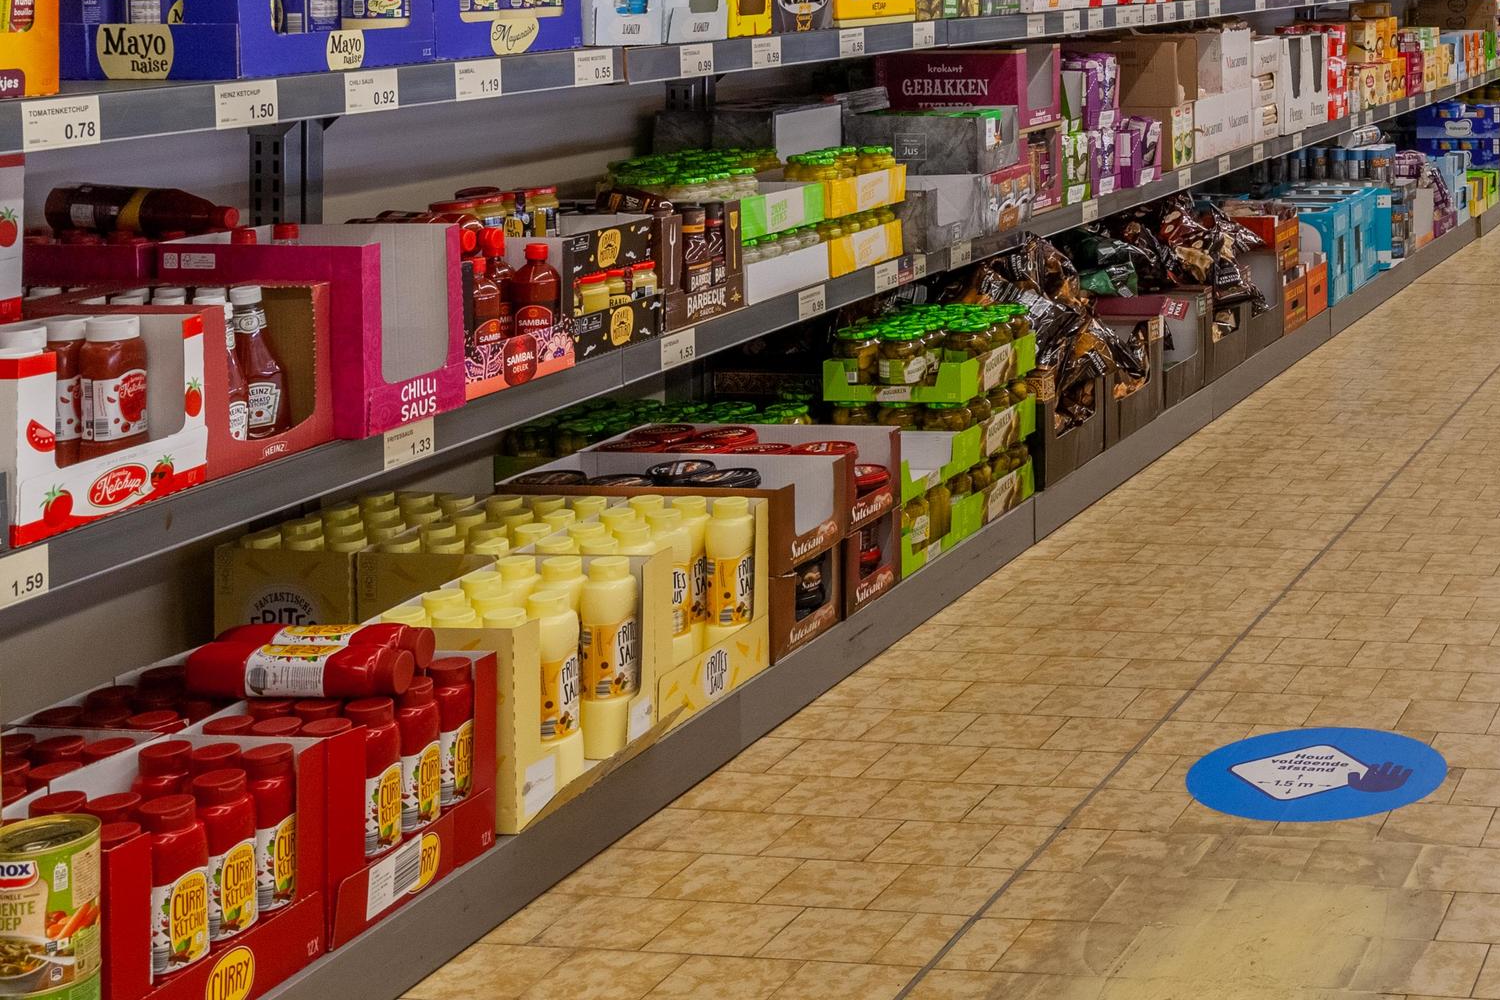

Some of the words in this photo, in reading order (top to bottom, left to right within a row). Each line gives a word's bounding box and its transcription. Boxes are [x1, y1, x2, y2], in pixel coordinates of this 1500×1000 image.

[103, 27, 166, 65] Mayo
[330, 33, 362, 56] Mayo
[130, 57, 169, 74] naise
[343, 52, 363, 65] naise
[697, 60, 712, 72] 0.99
[767, 52, 779, 63] 0.59
[595, 66, 611, 80] 0.55
[927, 63, 964, 74] krokant
[219, 91, 236, 100] HEINZ
[236, 88, 262, 98] KETCHUP
[480, 78, 499, 93] 1.19
[902, 77, 989, 96] GEBAKKEN
[373, 89, 396, 106] 0.92
[28, 104, 90, 118] TOMATENKETCHUP
[249, 102, 275, 120] 1.50
[64, 121, 96, 140] 0.78
[903, 145, 919, 157] Jus
[687, 287, 727, 318] BARBECUE
[518, 319, 549, 327] SAMBAL
[506, 350, 535, 367] SAMBAL
[678, 346, 694, 360] 1.53
[512, 363, 529, 374] OELEK
[400, 377, 437, 403] CHILLI
[400, 395, 437, 422] SAUS
[264, 443, 285, 457] HEINZ
[410, 437, 431, 455] 1.33
[11, 571, 44, 598] 1.59
[706, 647, 728, 676] FRITES
[709, 671, 725, 696] SAUS
[1271, 758, 1350, 768] voldoende
[1293, 752, 1335, 761] Houd
[1277, 764, 1337, 774] afstand
[1273, 779, 1293, 788] 1.5
[224, 857, 256, 890] CURRY
[225, 878, 256, 908] KETCHUP
[173, 882, 207, 922] CURRY
[174, 909, 208, 944] KETCHUP
[211, 956, 252, 1000] CURRY
